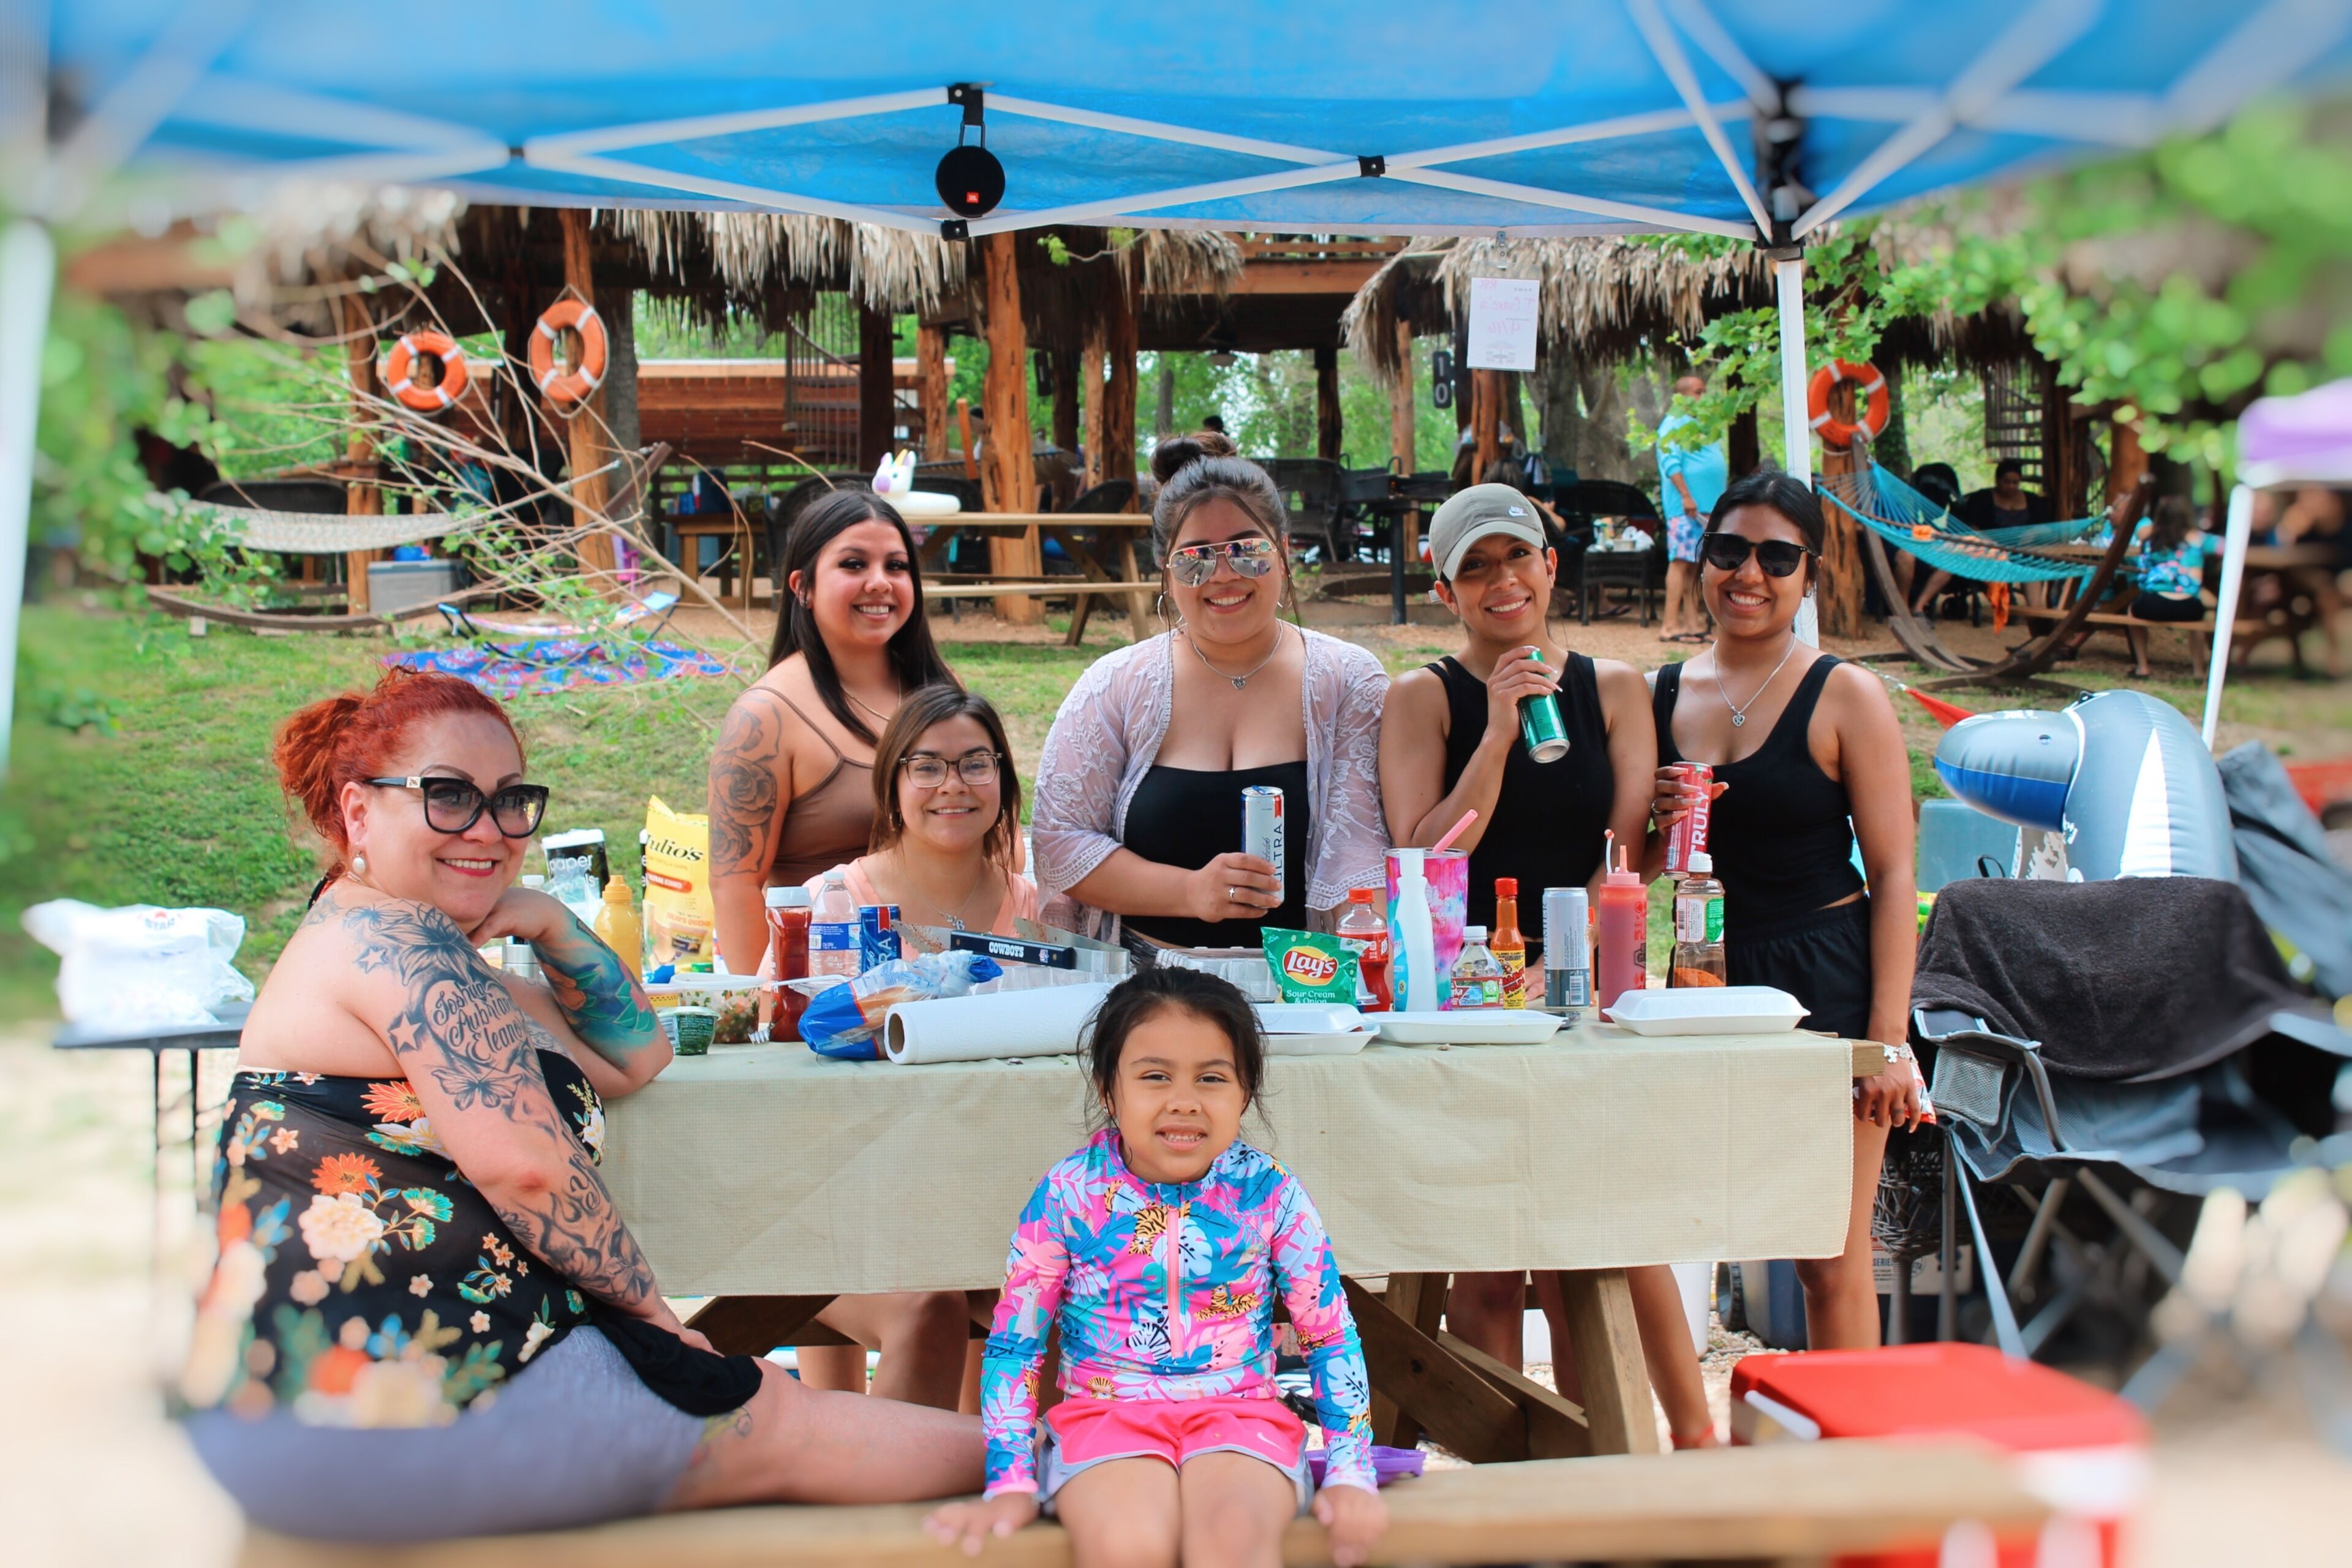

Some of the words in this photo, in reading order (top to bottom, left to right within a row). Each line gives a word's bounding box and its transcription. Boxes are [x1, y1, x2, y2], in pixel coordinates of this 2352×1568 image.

[1691, 791, 1709, 855] TRULY
[878, 938, 891, 963] RA
[989, 941, 1024, 958] COWBOYS
[1287, 951, 1335, 978] Lay's
[433, 981, 489, 1026] Joshua
[1873, 1257, 1893, 1266] SERIE
